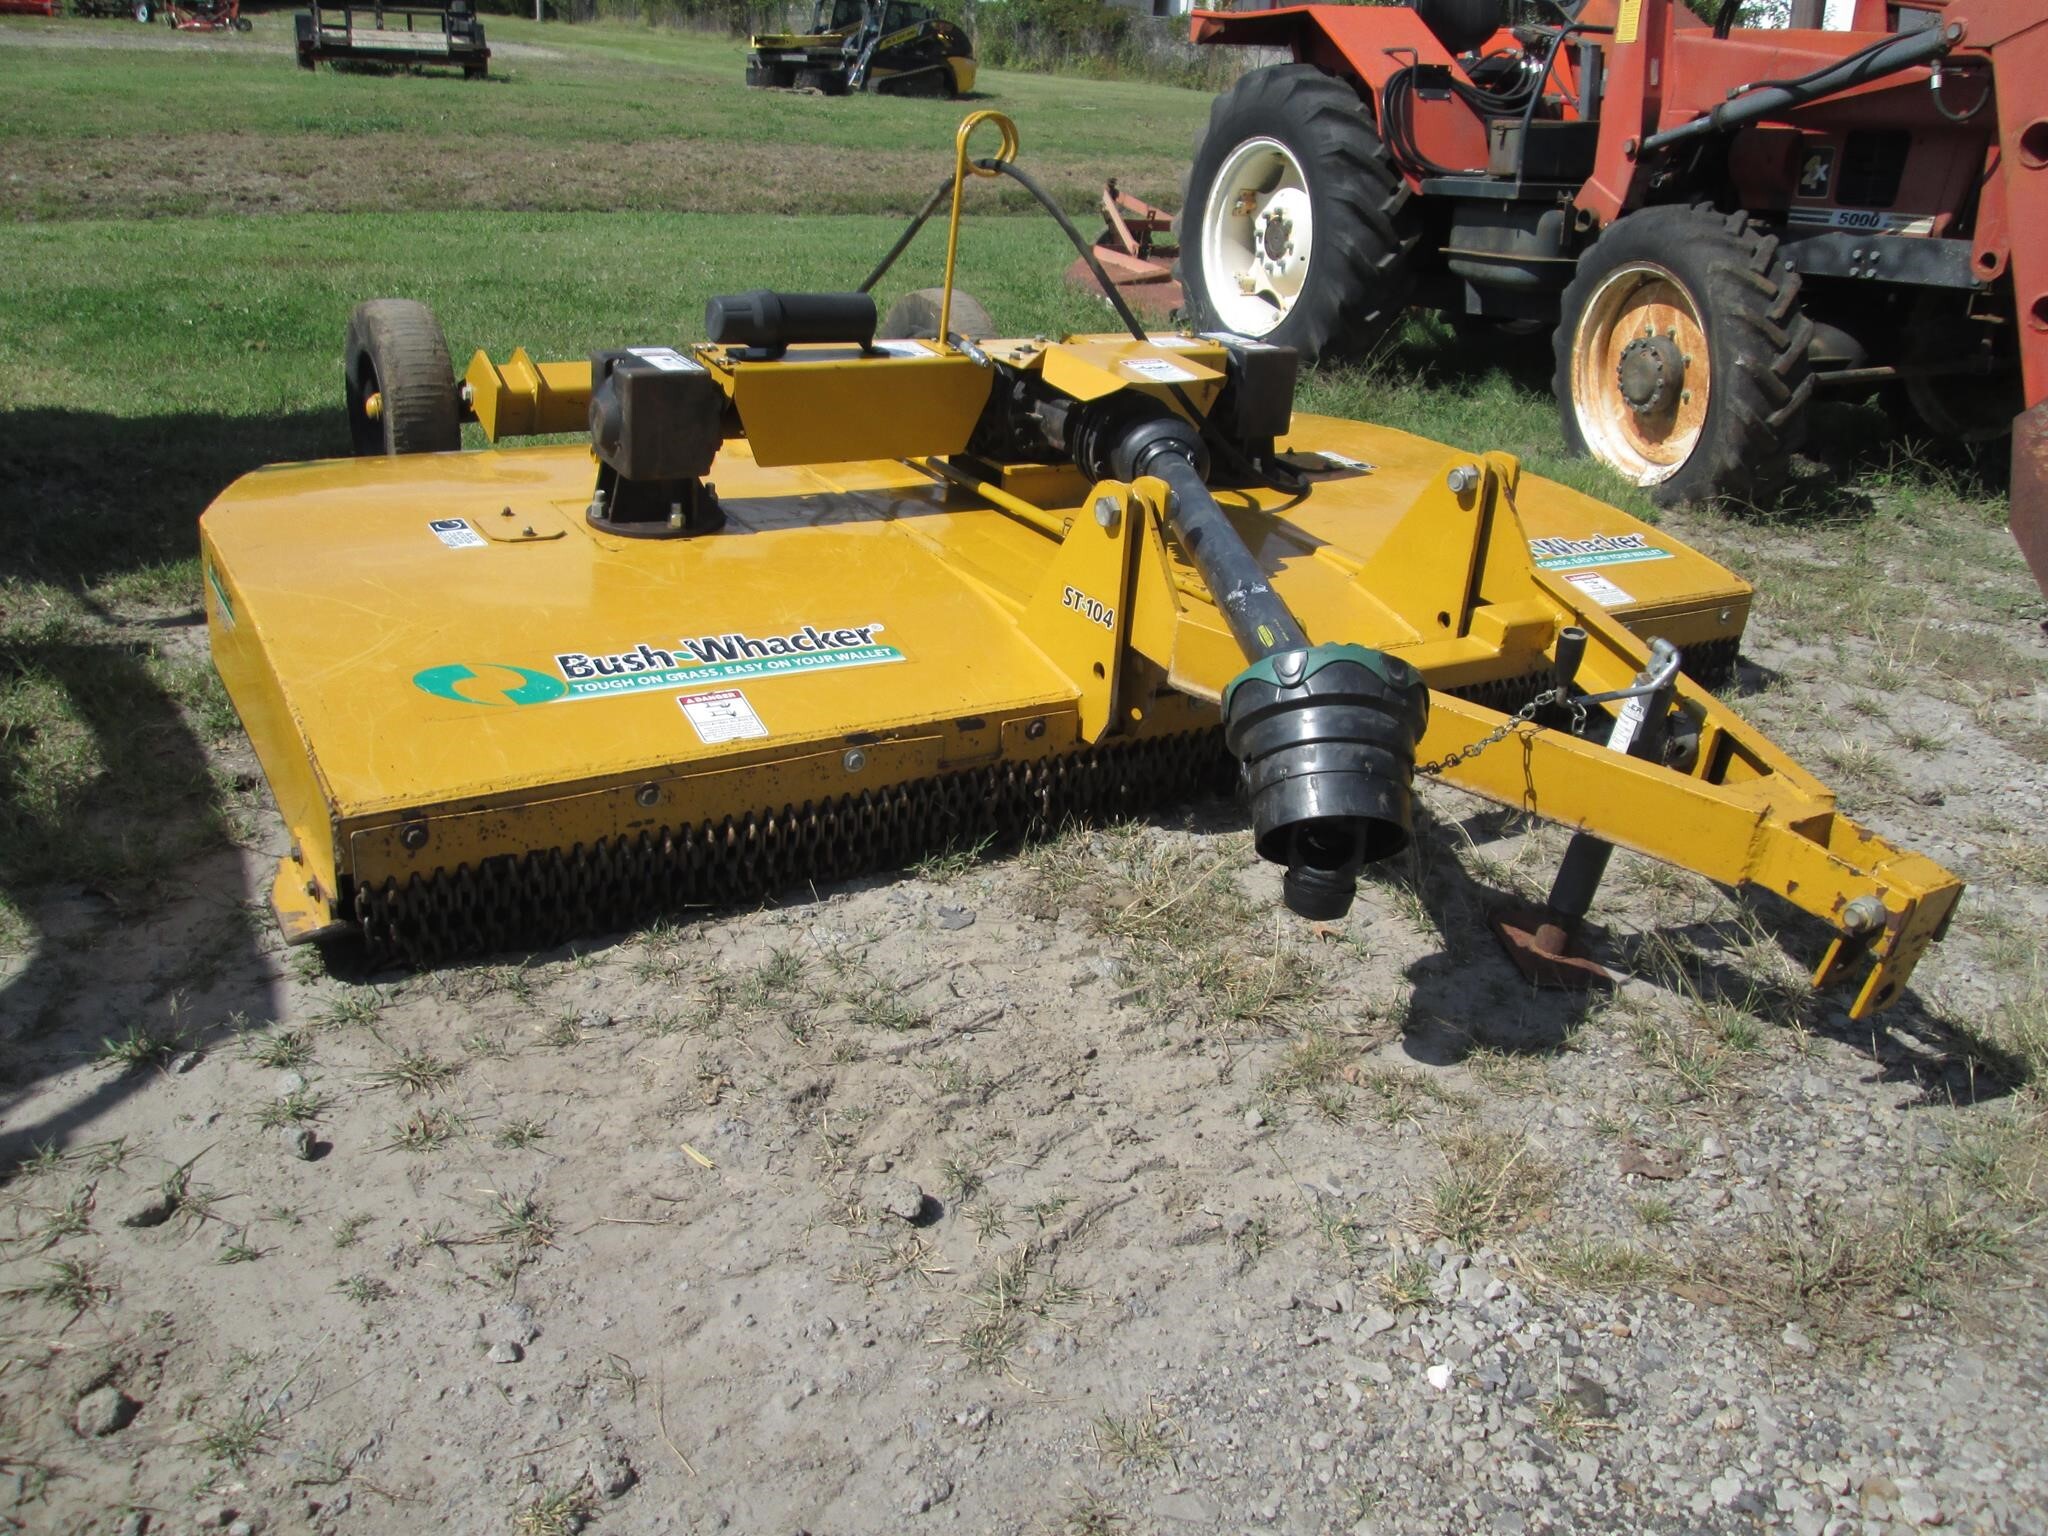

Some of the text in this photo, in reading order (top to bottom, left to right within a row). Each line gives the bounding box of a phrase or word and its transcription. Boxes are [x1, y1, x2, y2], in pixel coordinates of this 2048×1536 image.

[1837, 212, 1880, 228] 5000
[574, 647, 892, 693] TOUGH ON GRASS, EASY ON YOUR WALLET
[693, 692, 737, 703] DANGER
